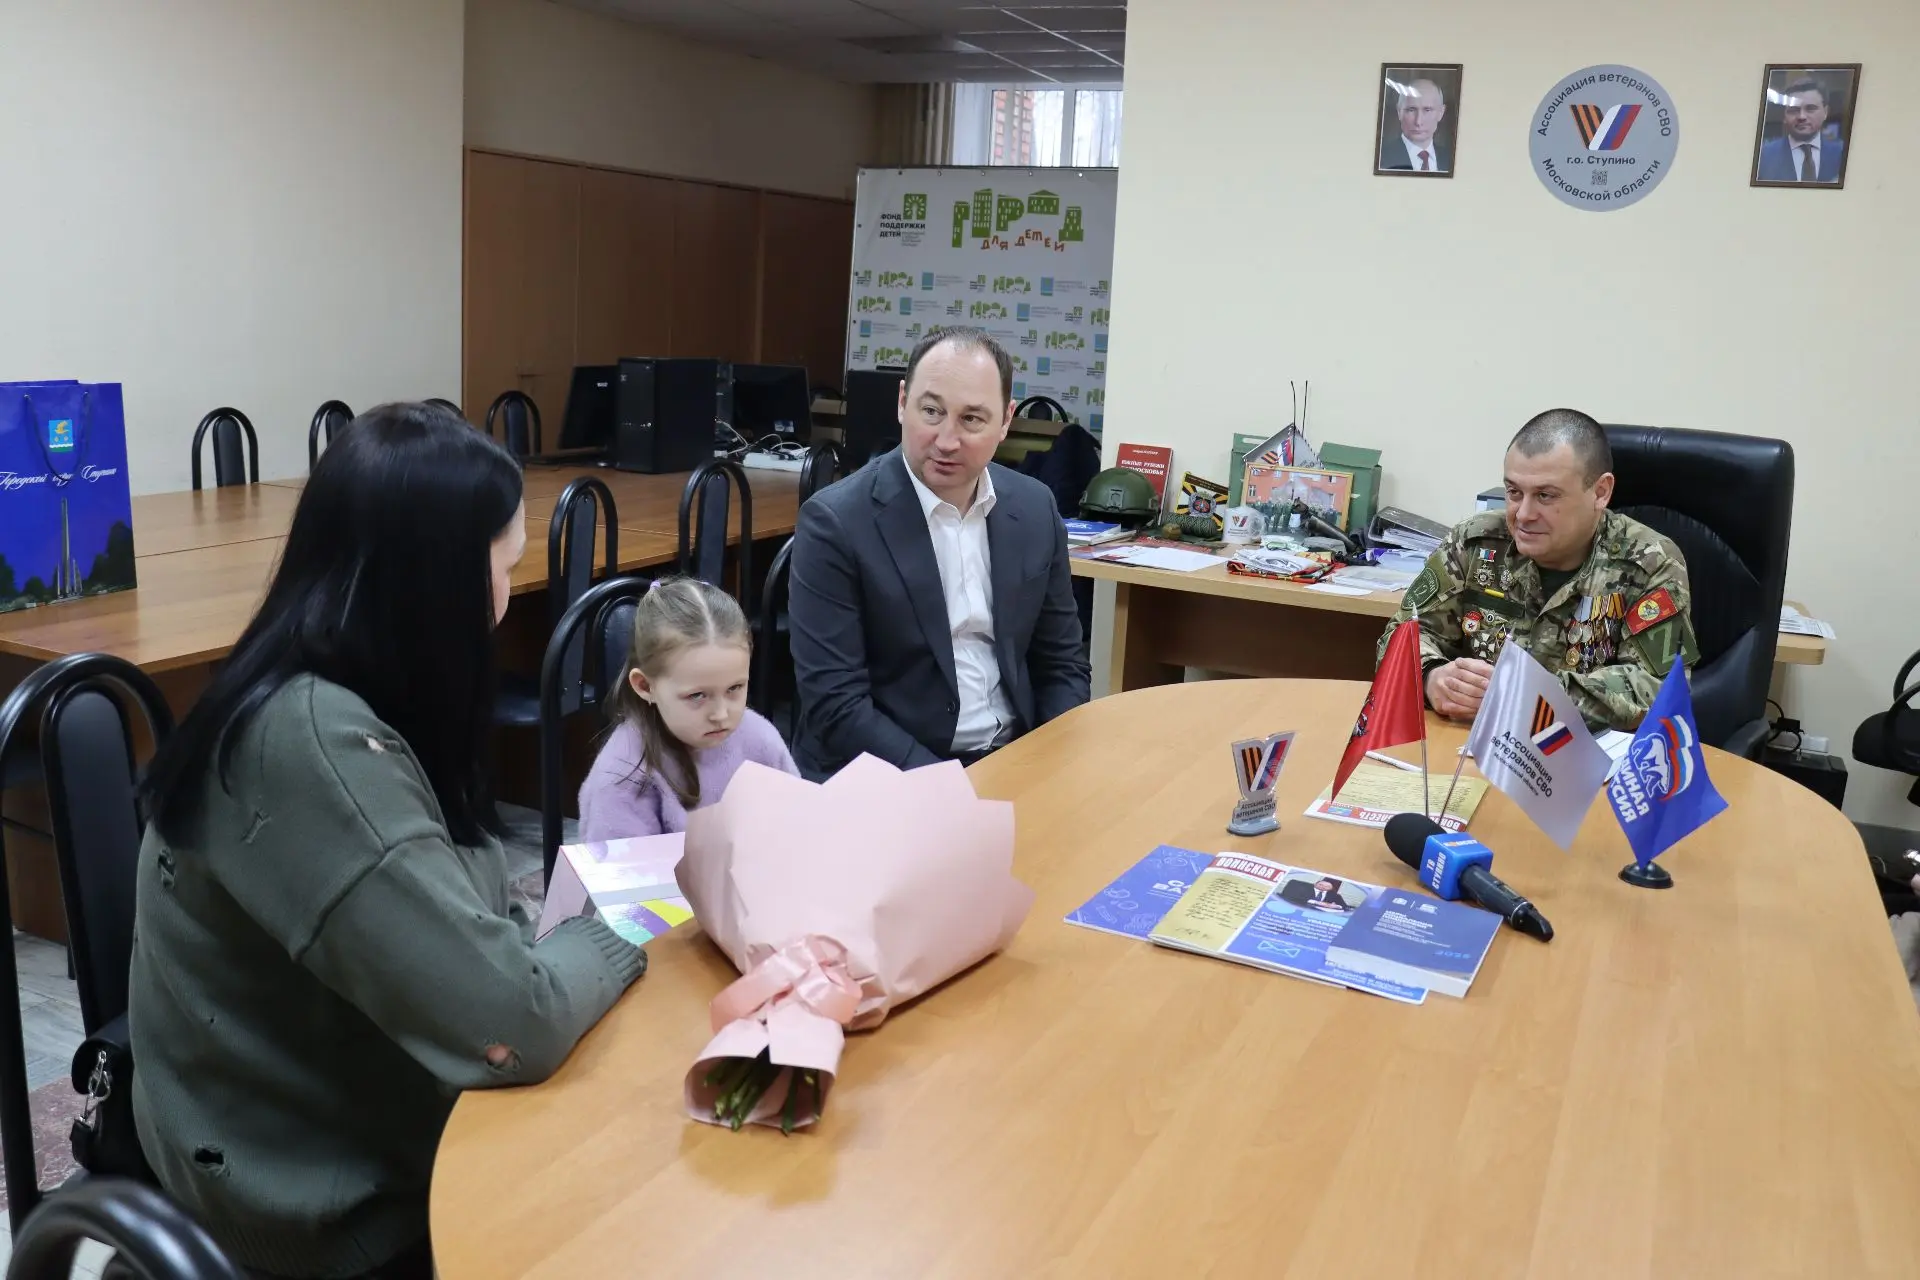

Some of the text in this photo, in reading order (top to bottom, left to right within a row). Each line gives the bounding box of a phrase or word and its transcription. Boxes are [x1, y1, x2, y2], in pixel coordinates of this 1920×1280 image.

[1537, 73, 1671, 137] Ассоциация ветеранов СВО
[1566, 155, 1636, 166] г.о. Ступино
[1542, 158, 1661, 201] Московской области
[880, 213, 901, 221] ФОНД
[1502, 730, 1553, 784] Ассоциация
[1536, 776, 1553, 798] СВО
[1215, 856, 1275, 879] ВОИНСКАЯ
